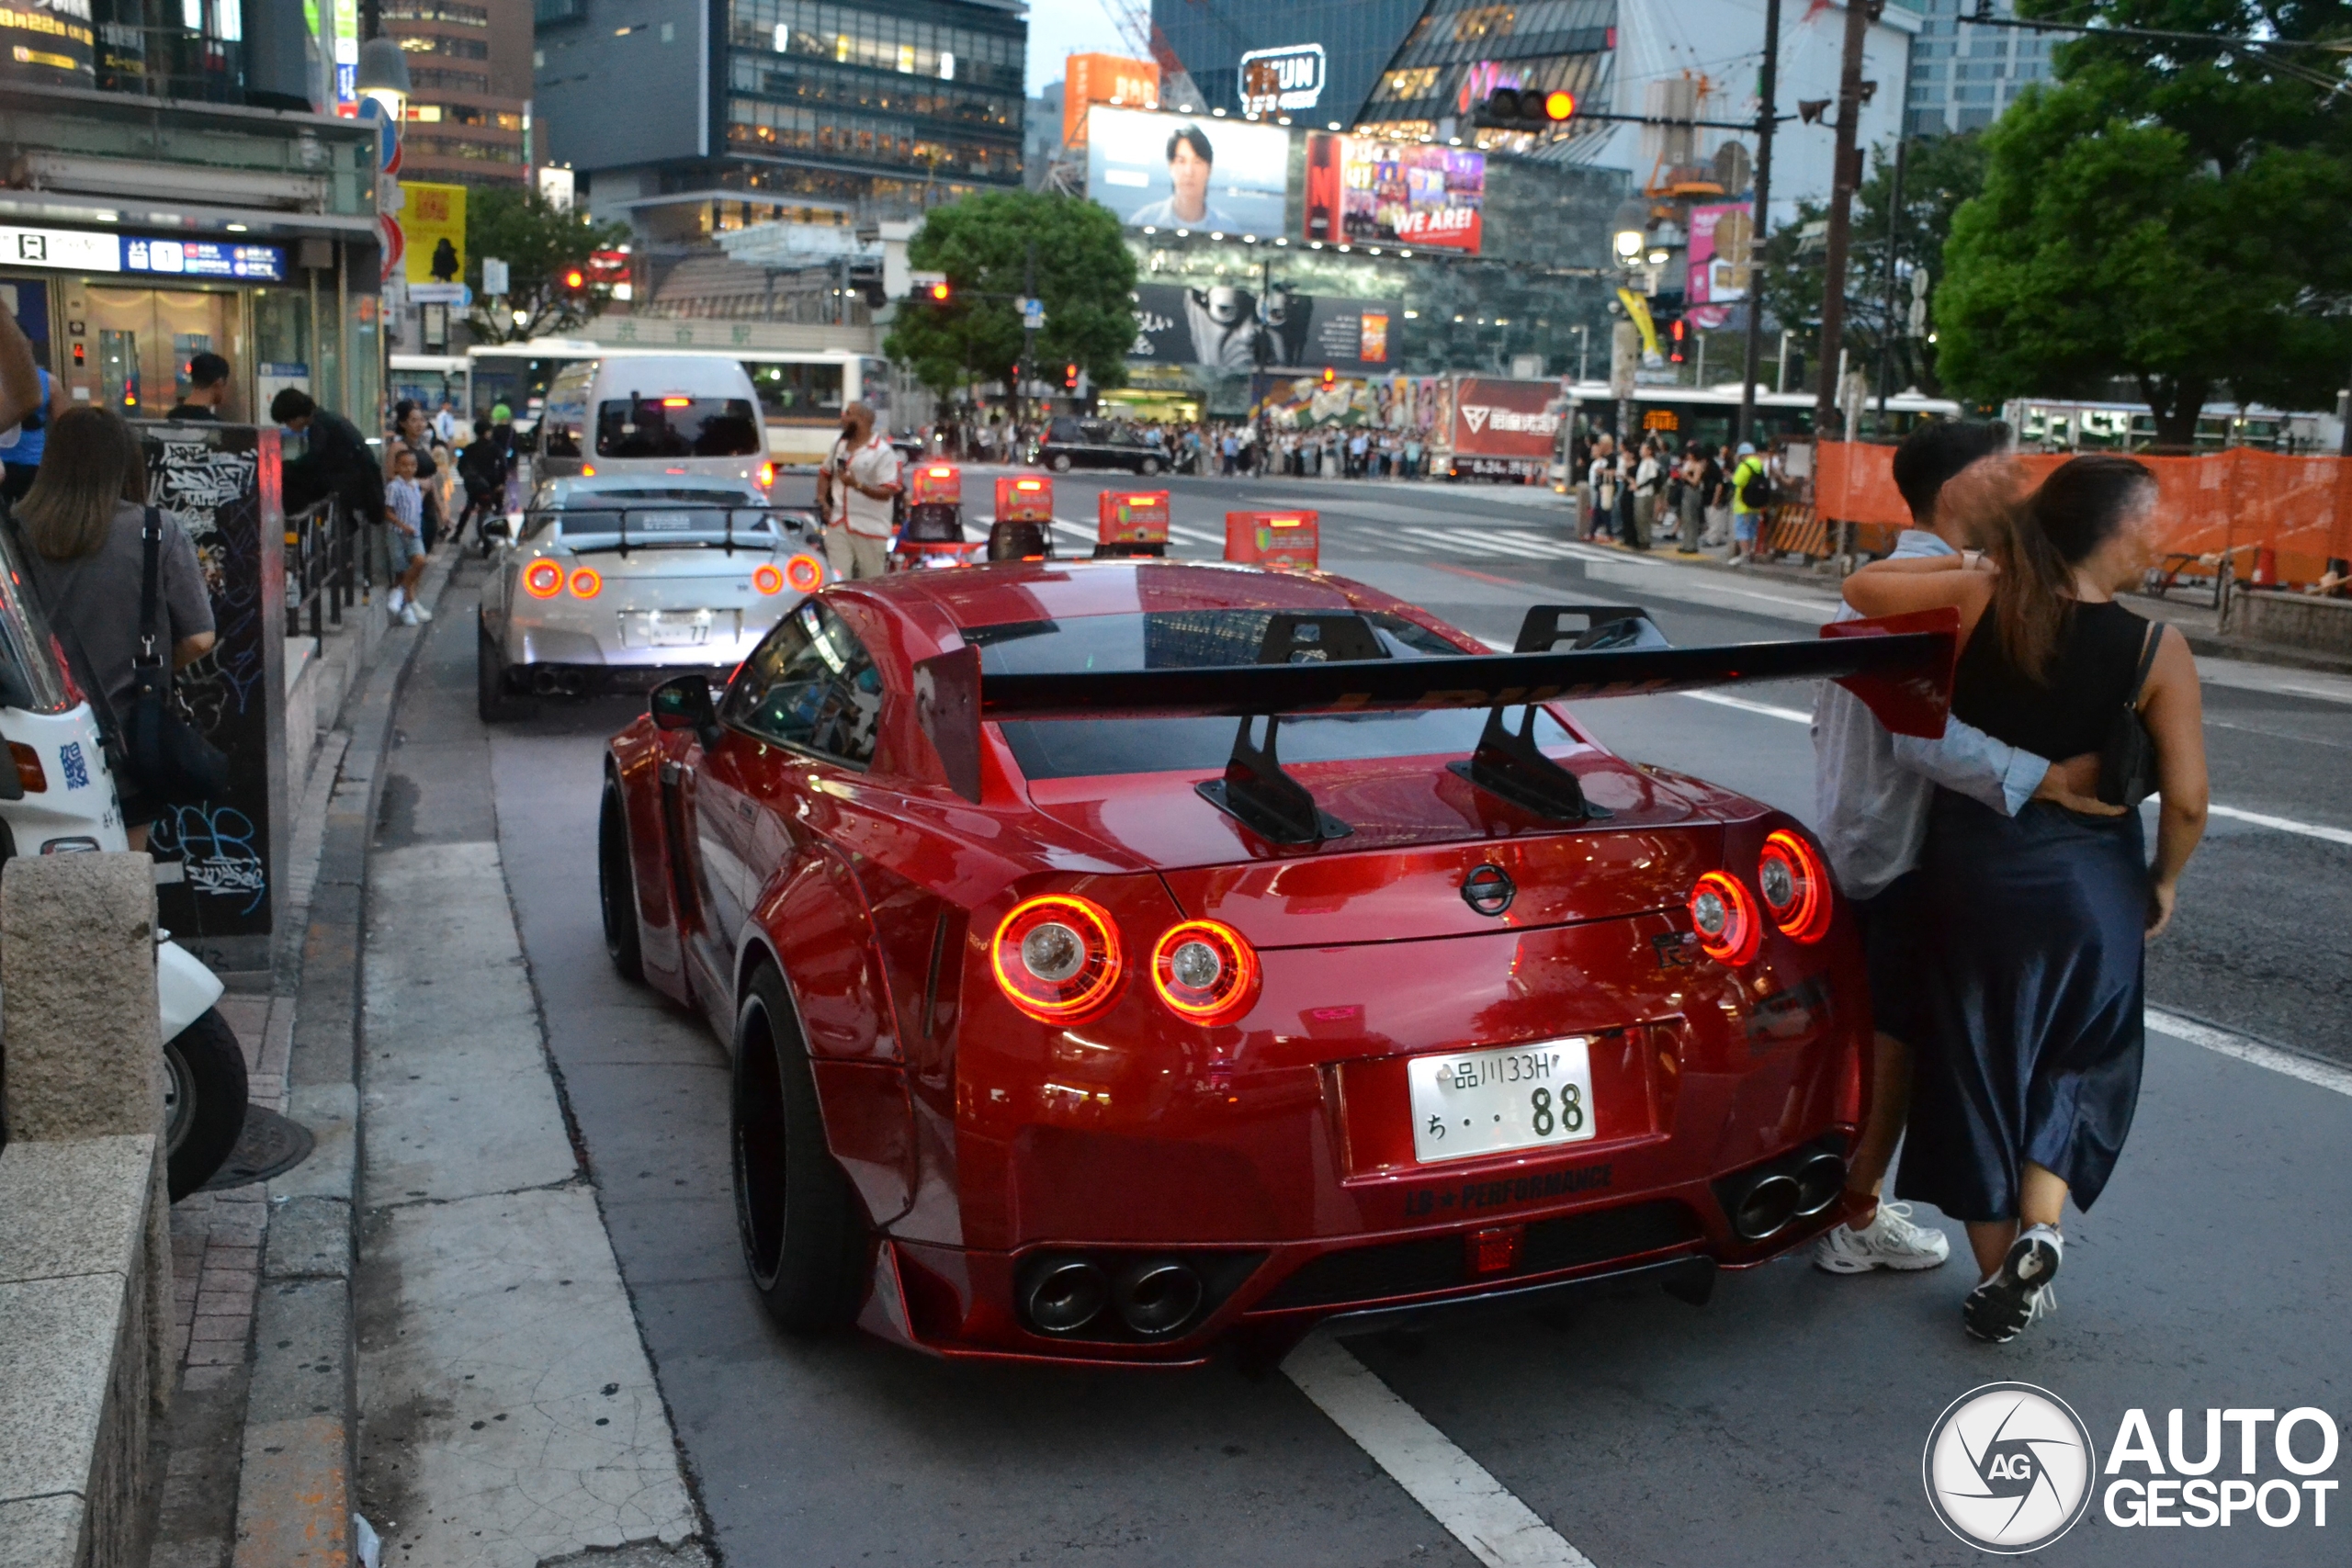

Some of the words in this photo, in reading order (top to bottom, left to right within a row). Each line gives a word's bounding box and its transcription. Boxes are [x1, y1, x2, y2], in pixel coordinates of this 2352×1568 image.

[1392, 212, 1426, 234] WE
[1429, 209, 1474, 230] ARE!
[689, 626, 708, 641] 77
[1532, 1083, 1583, 1136] 88
[1462, 1163, 1612, 1210] PERFORMANCE
